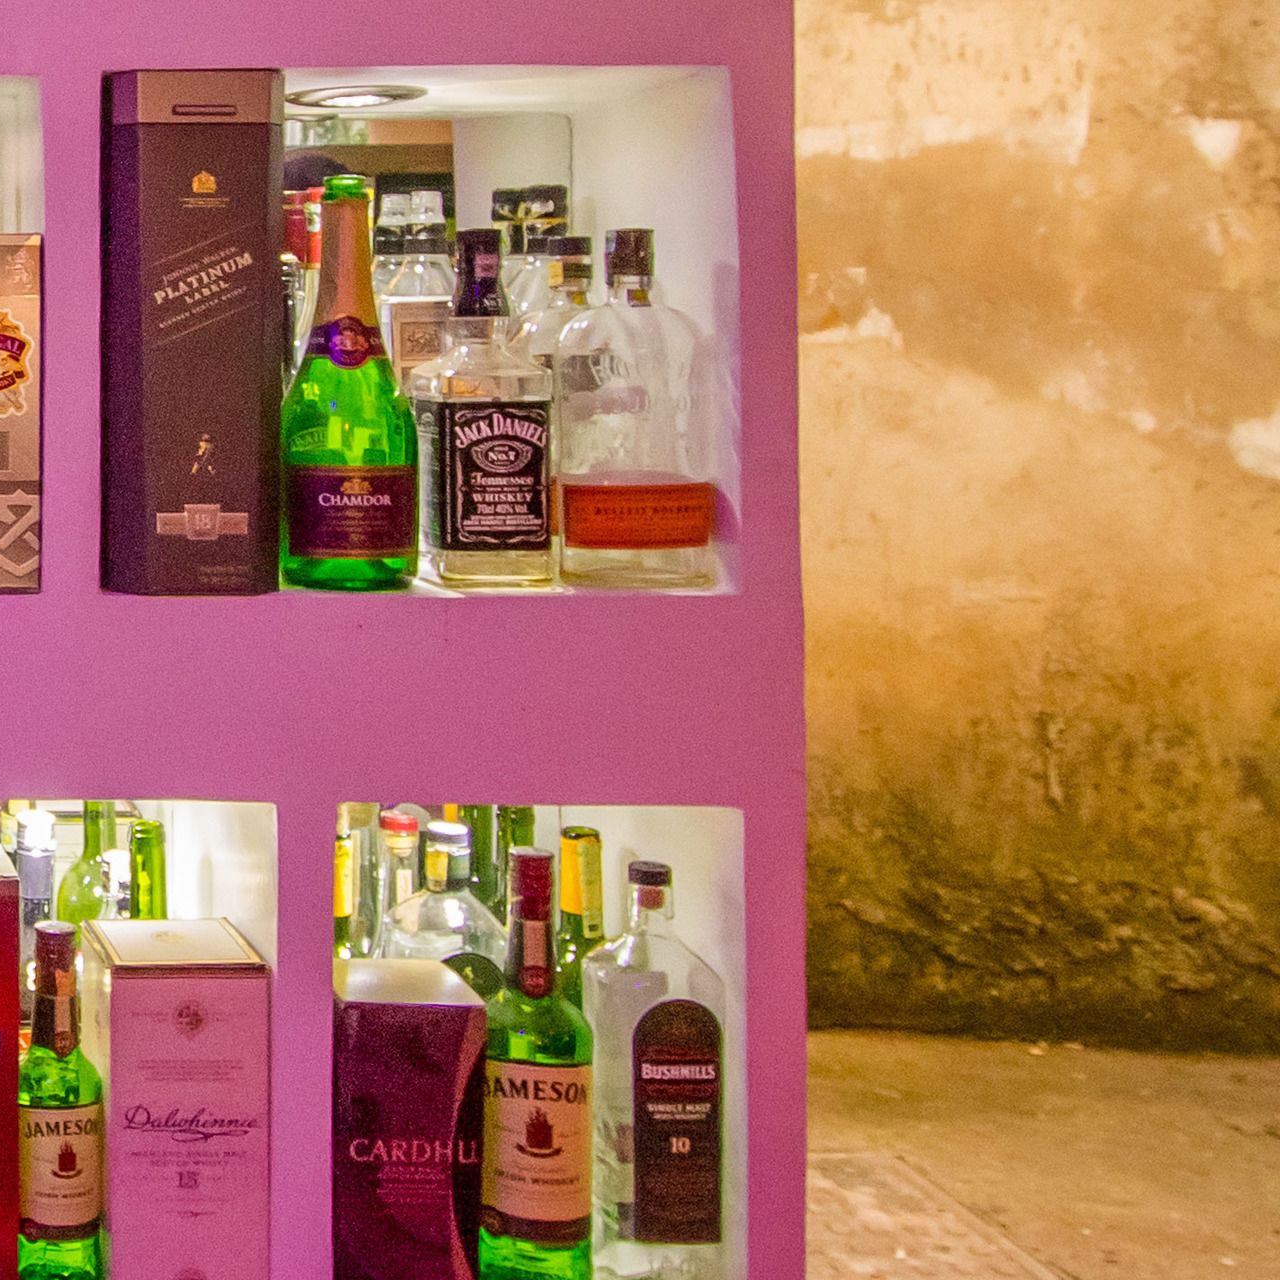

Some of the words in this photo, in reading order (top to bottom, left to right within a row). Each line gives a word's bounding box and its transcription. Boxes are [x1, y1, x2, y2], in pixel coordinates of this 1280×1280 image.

[153, 252, 253, 305] PLATINUM
[184, 281, 231, 304] LABEL
[454, 419, 492, 449] JACK
[318, 493, 392, 507] CHAMDOR
[472, 492, 534, 503] WHISKEY
[640, 1063, 717, 1080] BUSHMILLS
[350, 1139, 479, 1164] CARDHU
[670, 1137, 692, 1154] 10
